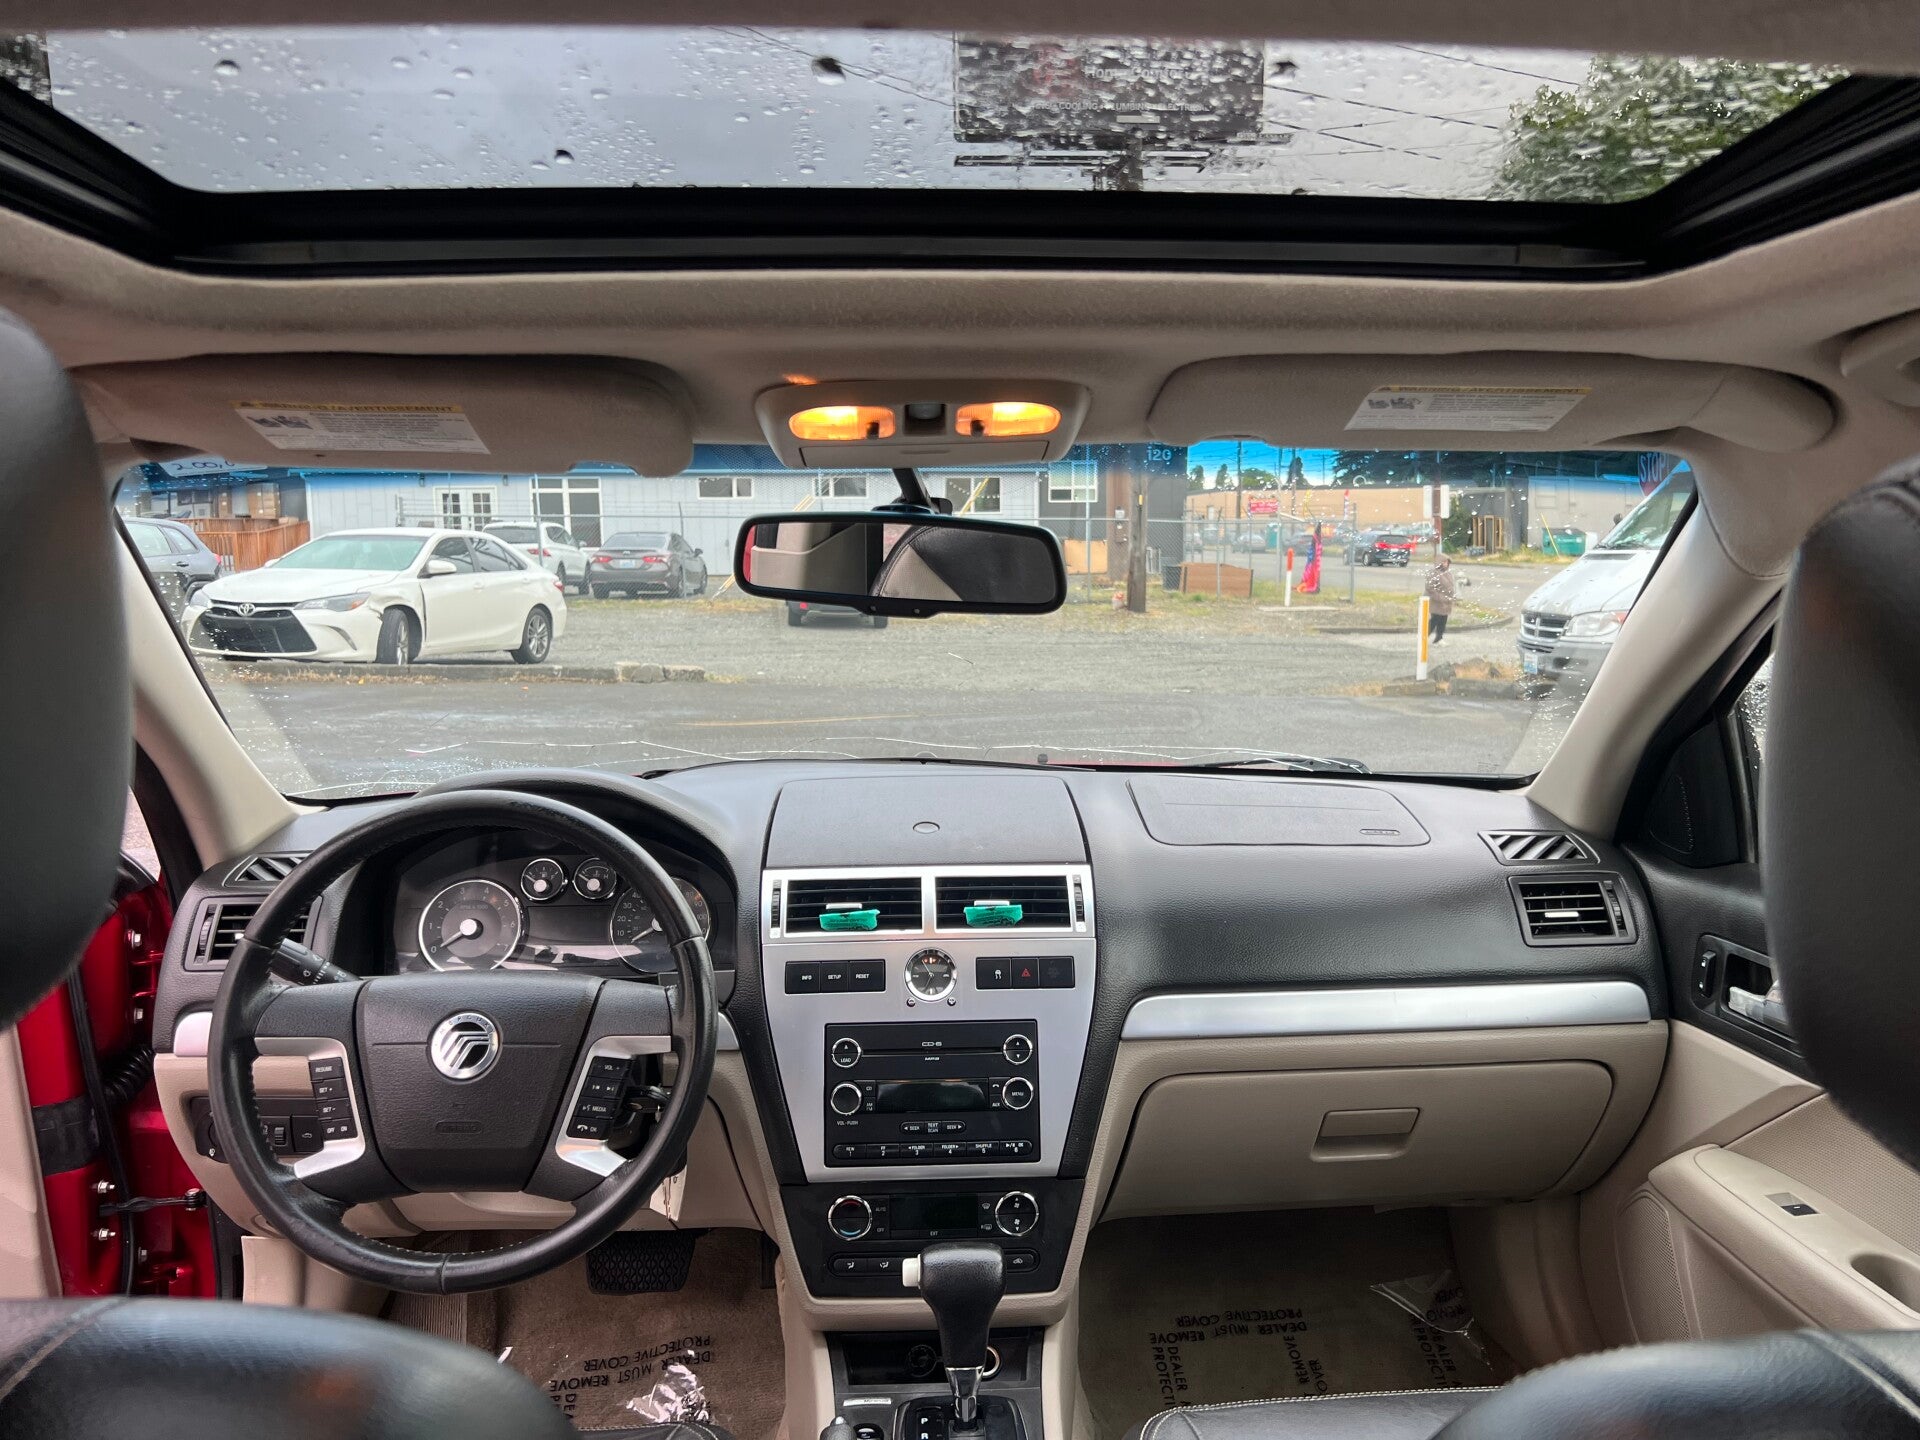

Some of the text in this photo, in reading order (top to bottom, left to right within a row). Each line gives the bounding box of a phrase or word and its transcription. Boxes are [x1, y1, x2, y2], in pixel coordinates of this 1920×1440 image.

[1640, 452, 1666, 482] STOP
[1177, 1308, 1303, 1327] PROTECTIVE COVER
[1150, 1322, 1307, 1344] DEALER MUST REMOVE
[584, 1335, 711, 1372] PROTECTIVE COVER
[1284, 1336, 1310, 1385] REMOVE
[618, 1363, 652, 1384] MUST
[1168, 1346, 1188, 1391] DEALER
[550, 1374, 609, 1392] REMOVE
